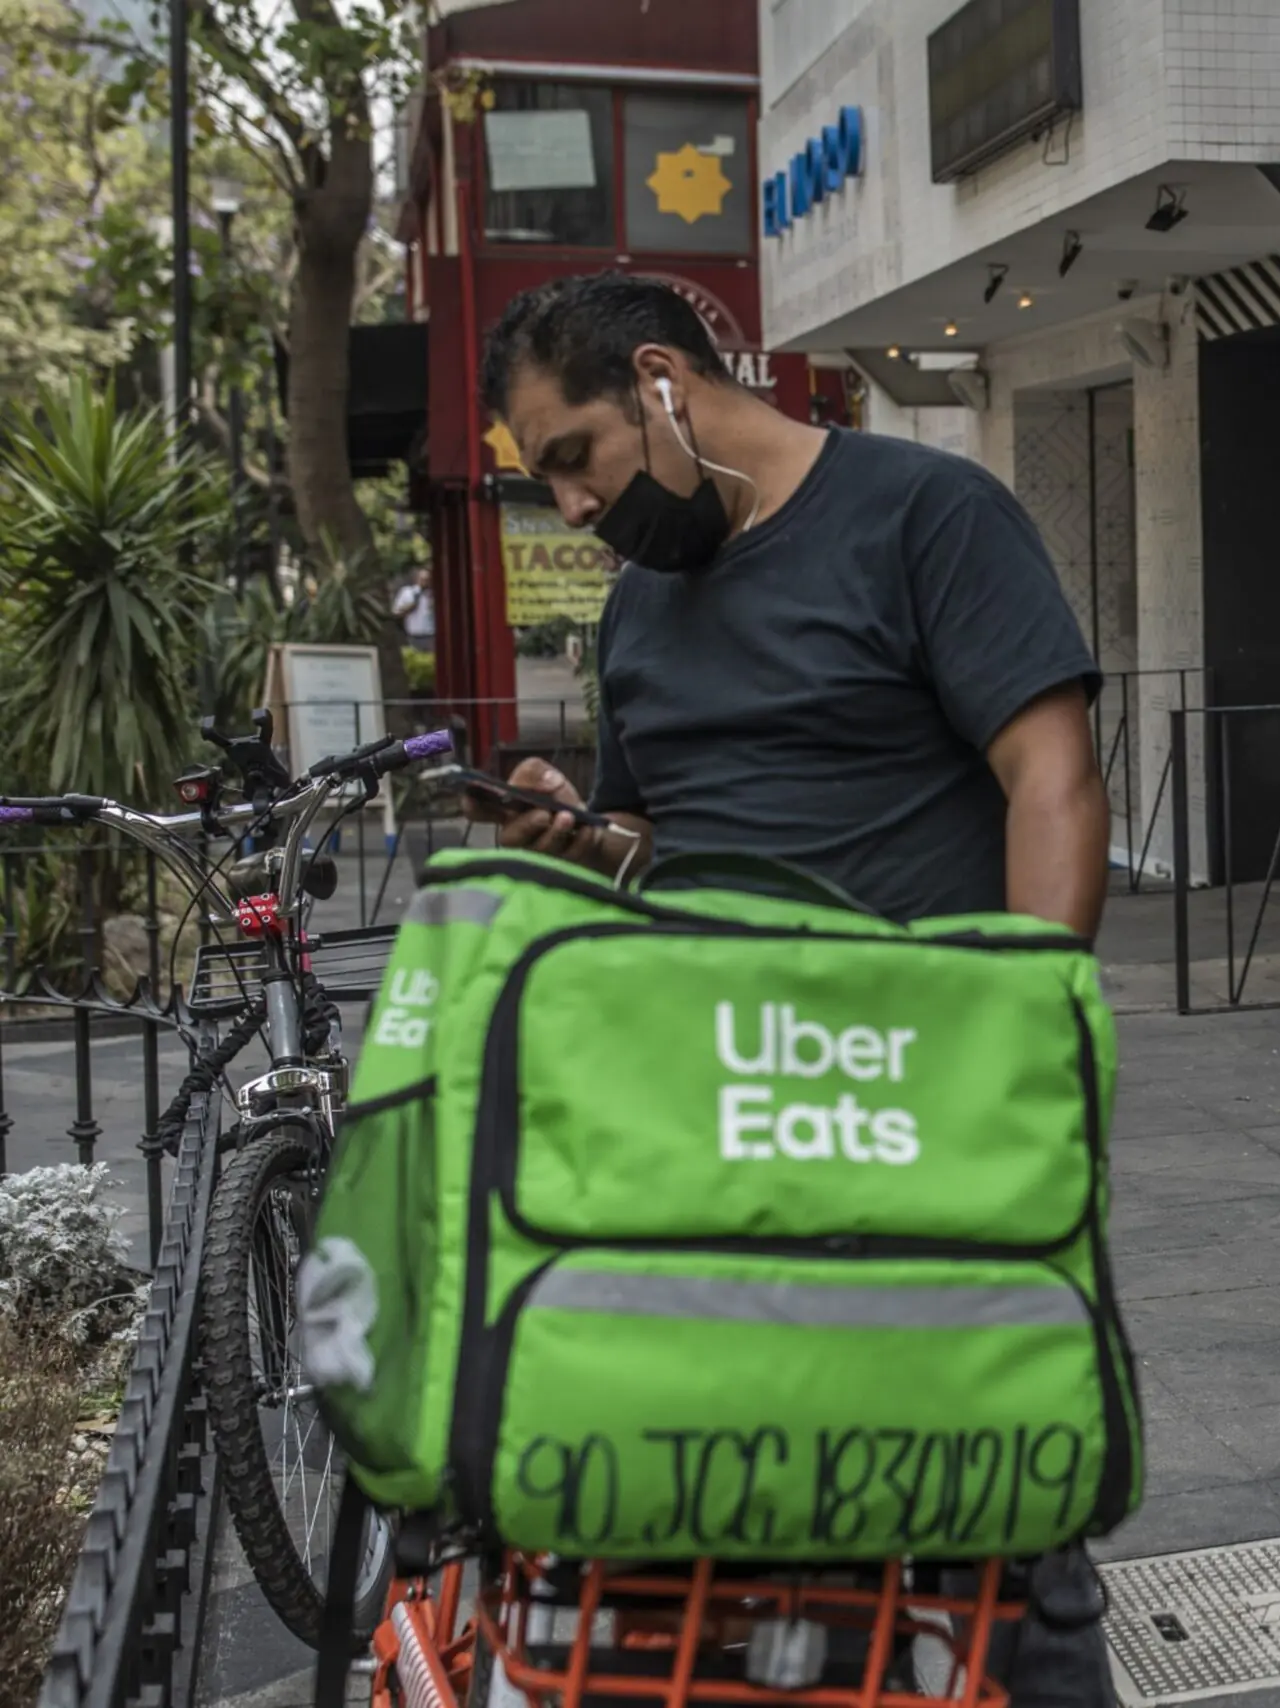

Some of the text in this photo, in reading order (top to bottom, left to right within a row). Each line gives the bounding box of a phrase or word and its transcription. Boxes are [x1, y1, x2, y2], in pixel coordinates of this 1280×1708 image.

[390, 966, 440, 1007] Ub
[374, 1007, 430, 1049] Ea
[715, 999, 918, 1083] Uber
[717, 1083, 922, 1167] Eats
